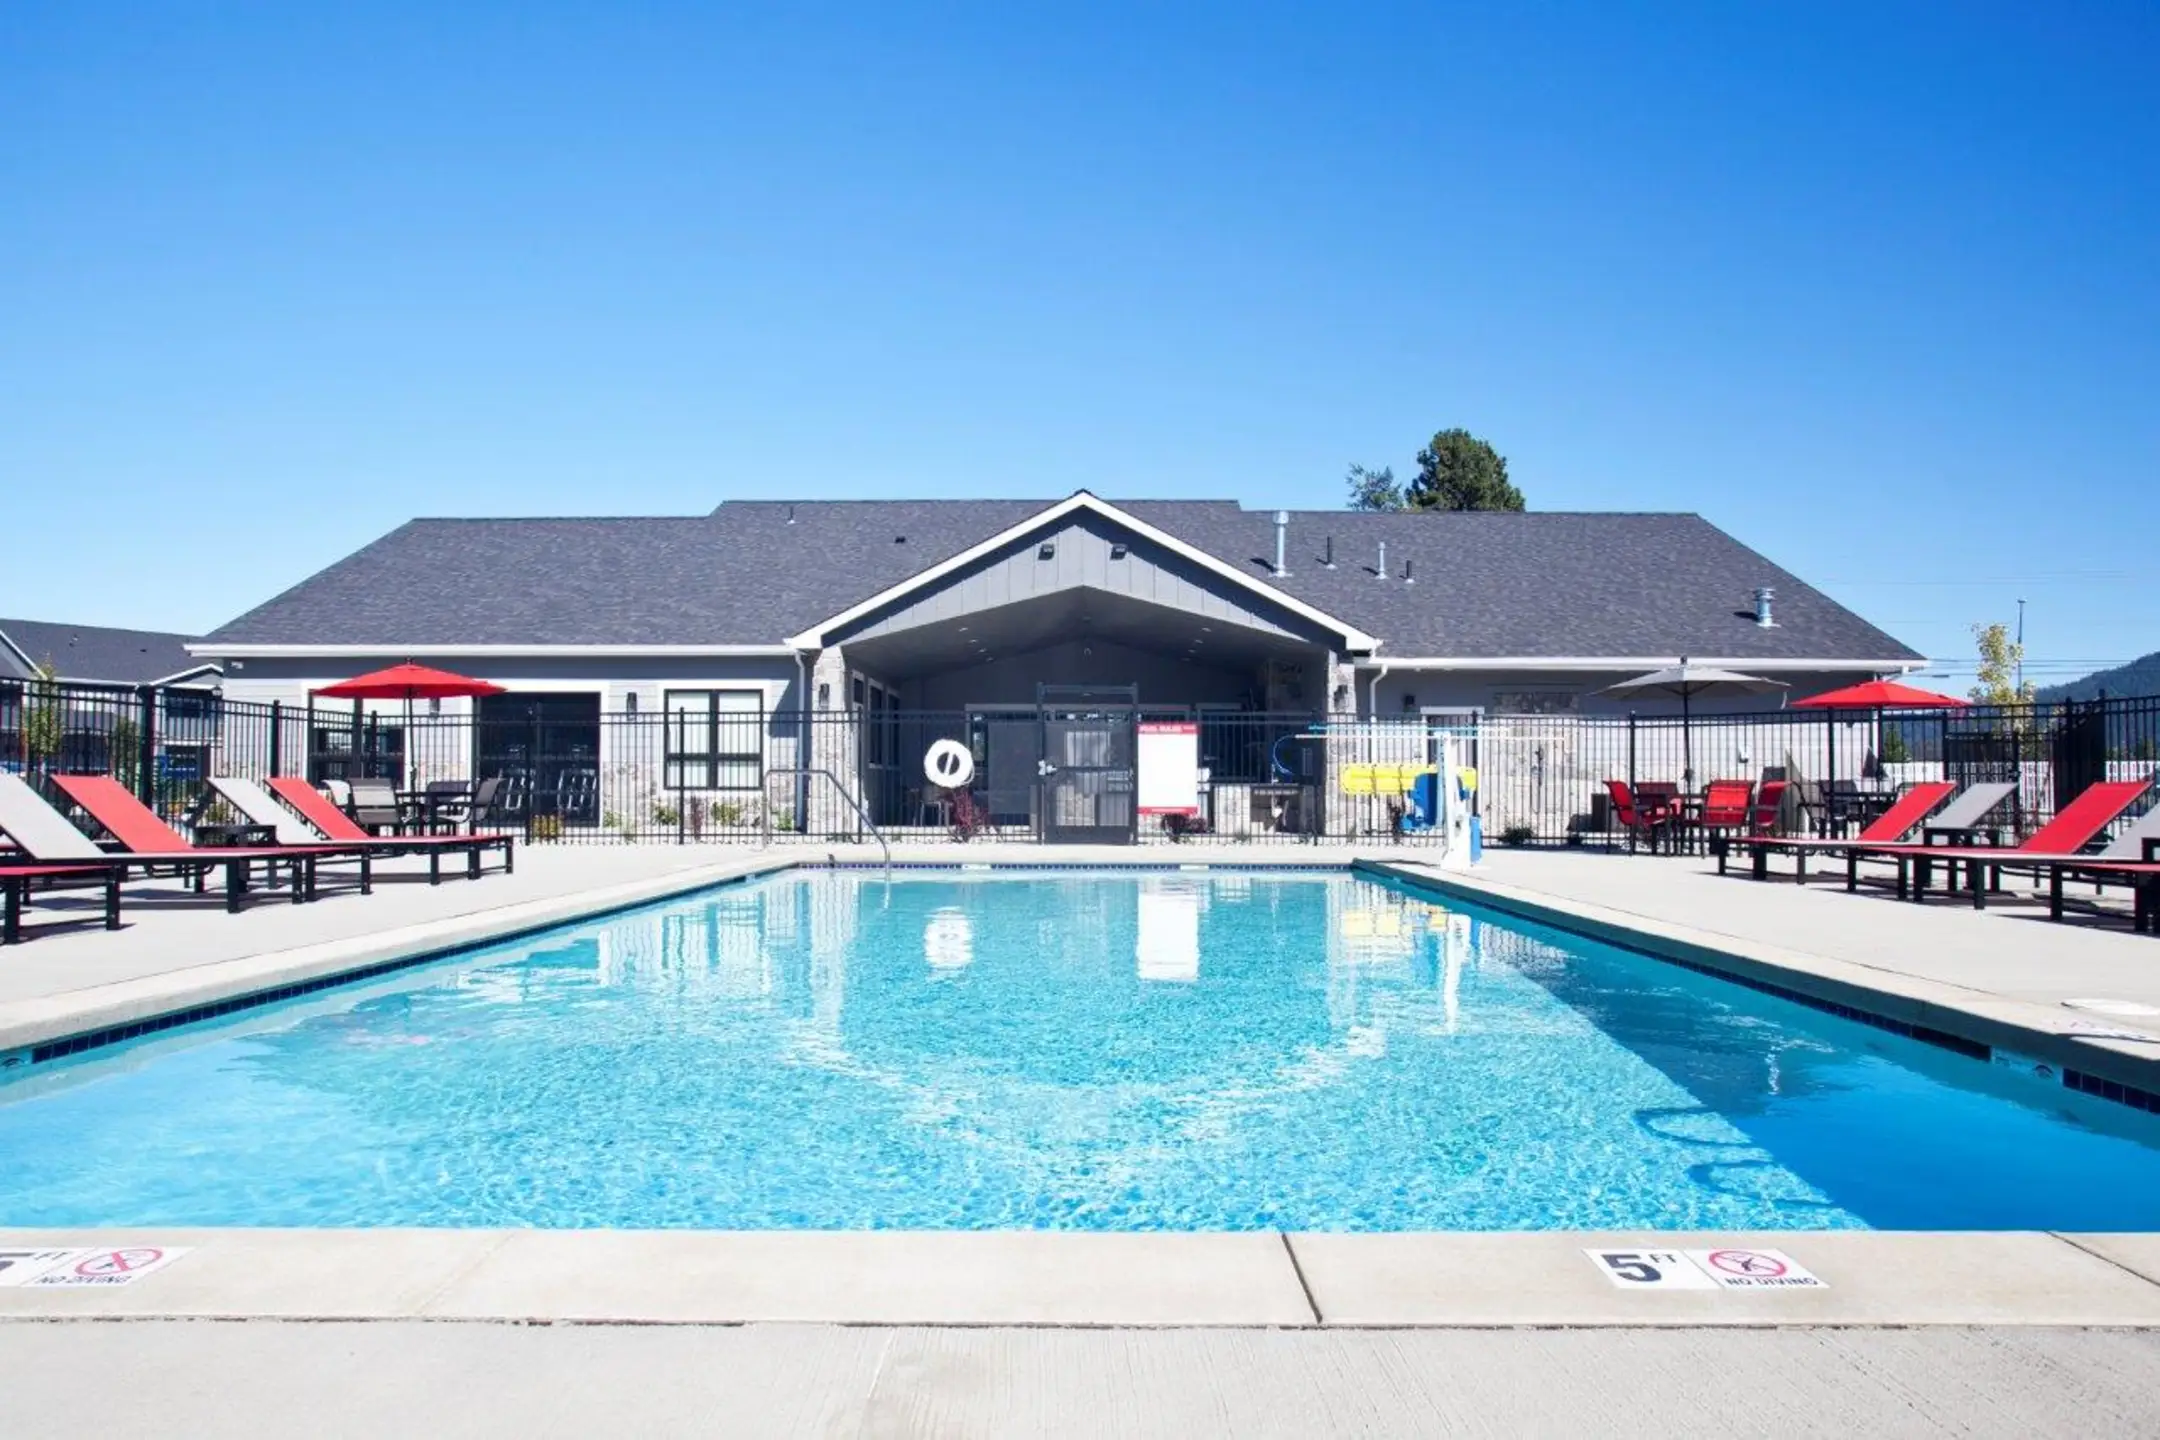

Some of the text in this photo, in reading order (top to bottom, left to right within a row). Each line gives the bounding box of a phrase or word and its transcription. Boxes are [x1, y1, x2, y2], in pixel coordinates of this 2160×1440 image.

[1600, 1254, 1677, 1282] 5 FT
[1725, 1277, 1819, 1286] NO DIVING
